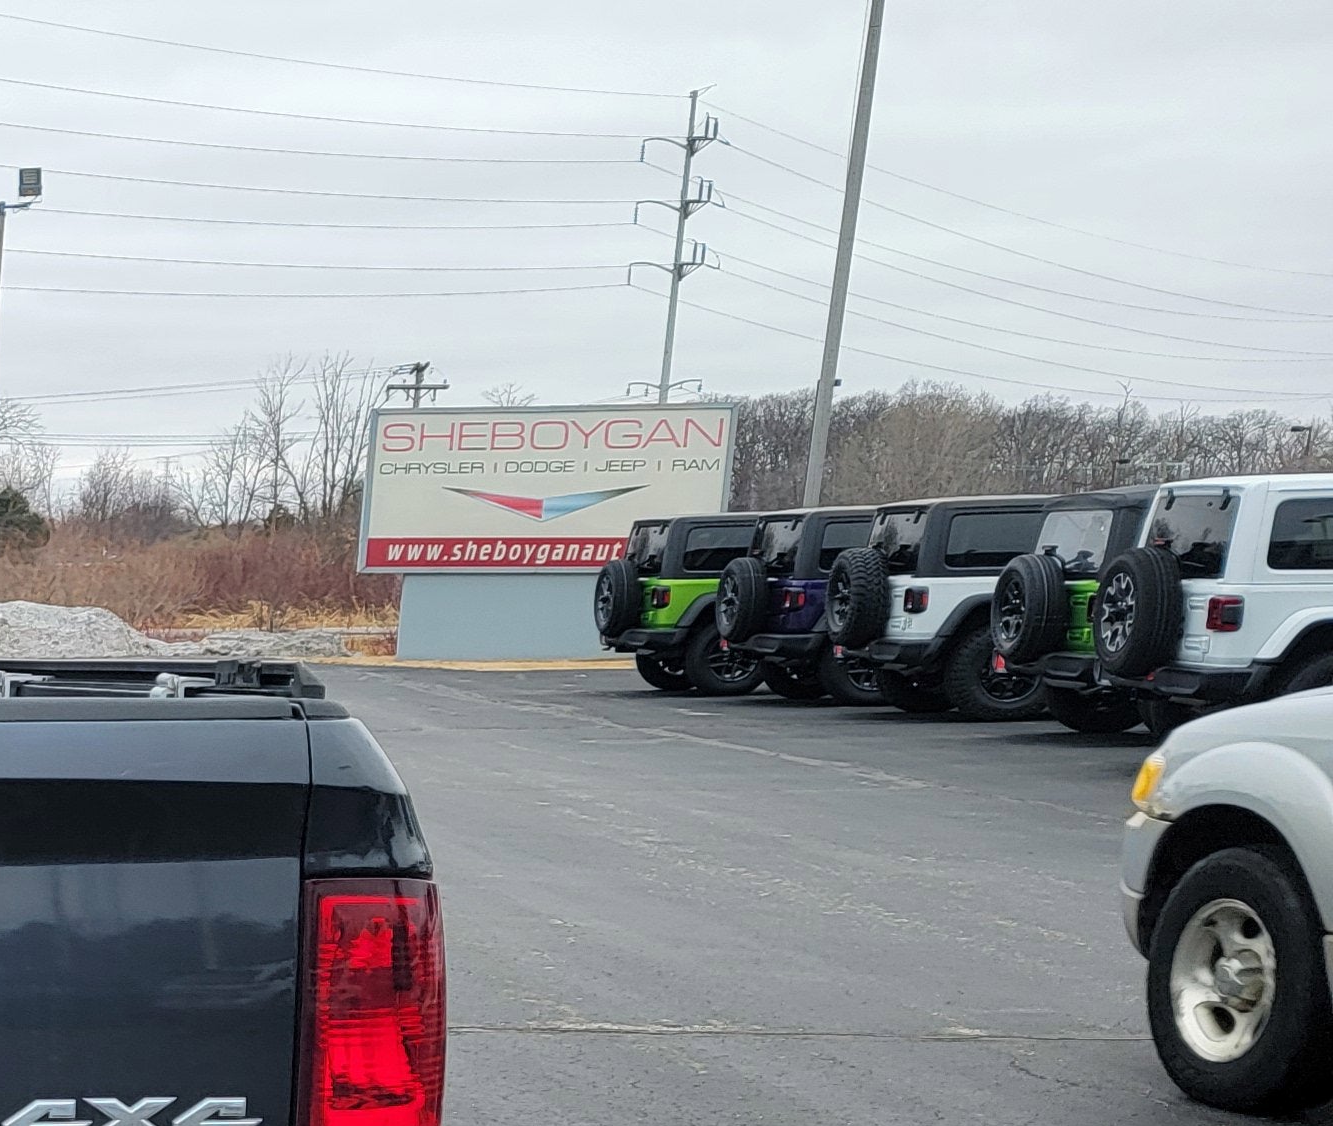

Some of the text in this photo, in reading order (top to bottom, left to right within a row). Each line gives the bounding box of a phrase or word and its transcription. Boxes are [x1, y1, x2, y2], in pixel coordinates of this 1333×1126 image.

[381, 417, 725, 453] SHEBOYGAN
[379, 458, 721, 475] CHRYSLER DODGE JEEP RAM
